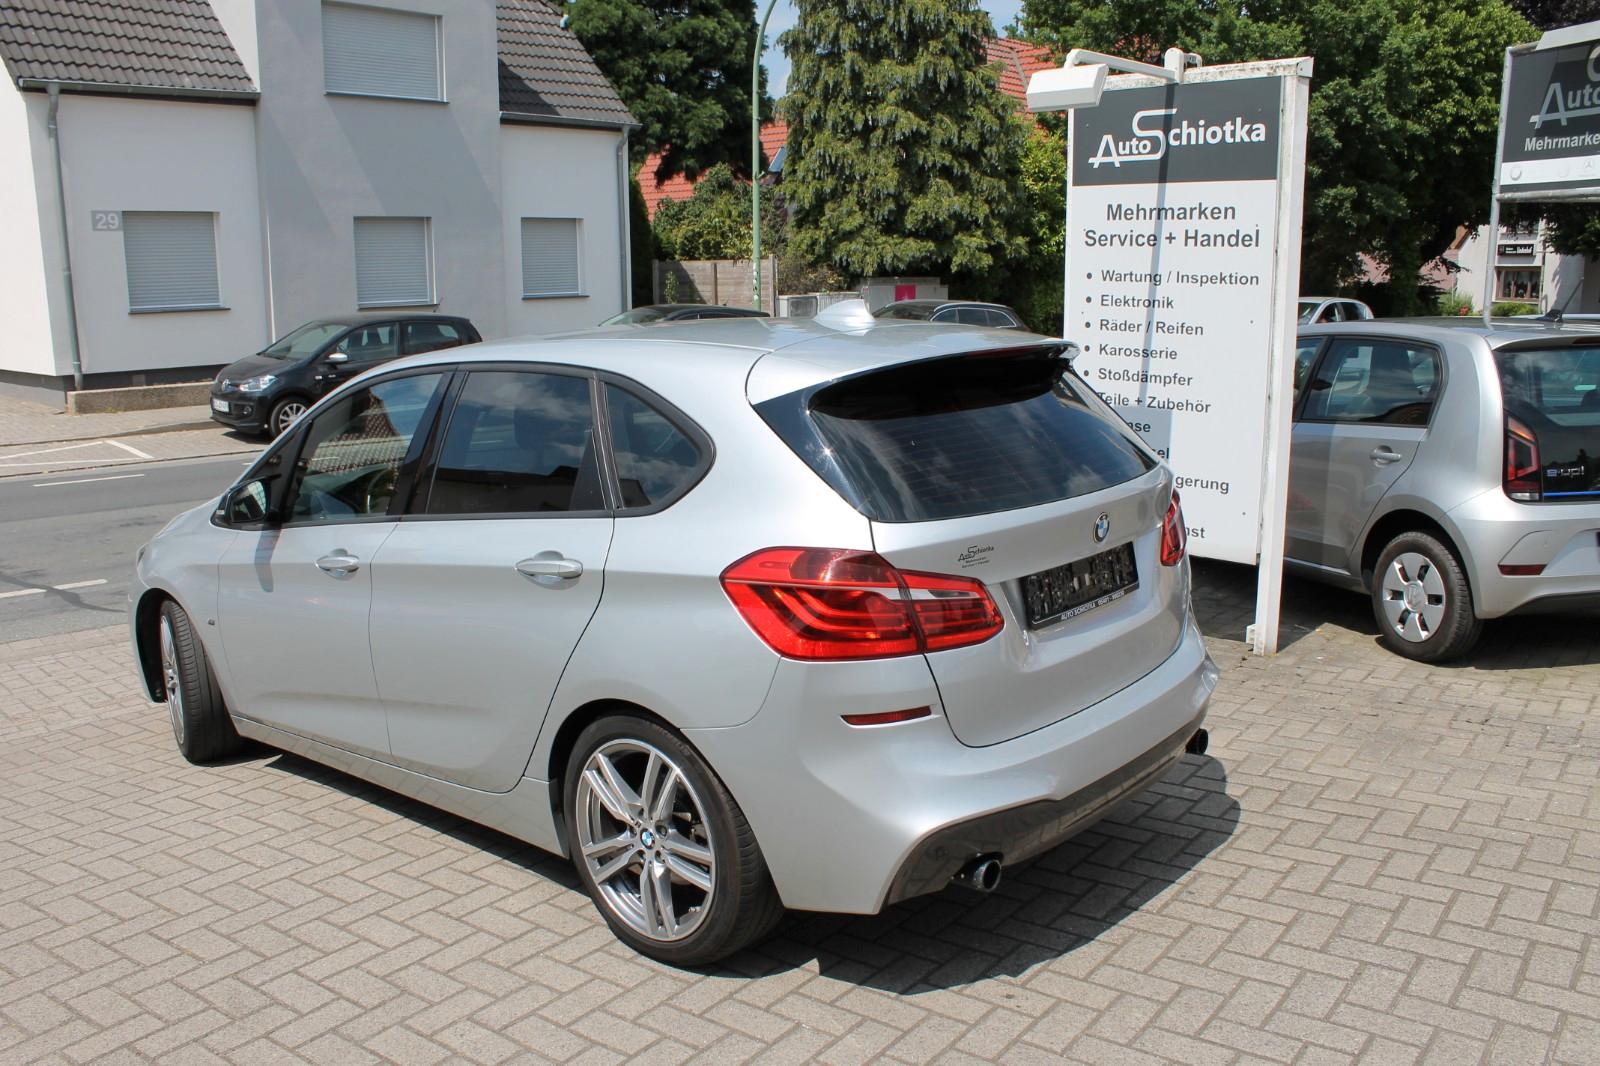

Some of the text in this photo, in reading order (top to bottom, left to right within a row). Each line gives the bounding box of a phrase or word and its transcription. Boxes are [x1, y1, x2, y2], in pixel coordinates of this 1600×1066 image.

[1524, 131, 1600, 151] Mehrmarke
[95, 212, 119, 229] 29
[1106, 202, 1236, 221] Mehrmarken
[1084, 228, 1259, 247] Service + Handel
[1101, 269, 1162, 284] Wartung
[1176, 270, 1259, 286] Inspektion
[1100, 294, 1174, 309] Elektronik
[1099, 318, 1142, 333] Räder
[1156, 321, 1204, 336] Reifen
[1099, 343, 1178, 360] Karosserie
[1098, 367, 1193, 387] Stoßdämpfer
[1134, 397, 1143, 405] +
[1147, 395, 1211, 413] Zubehör
